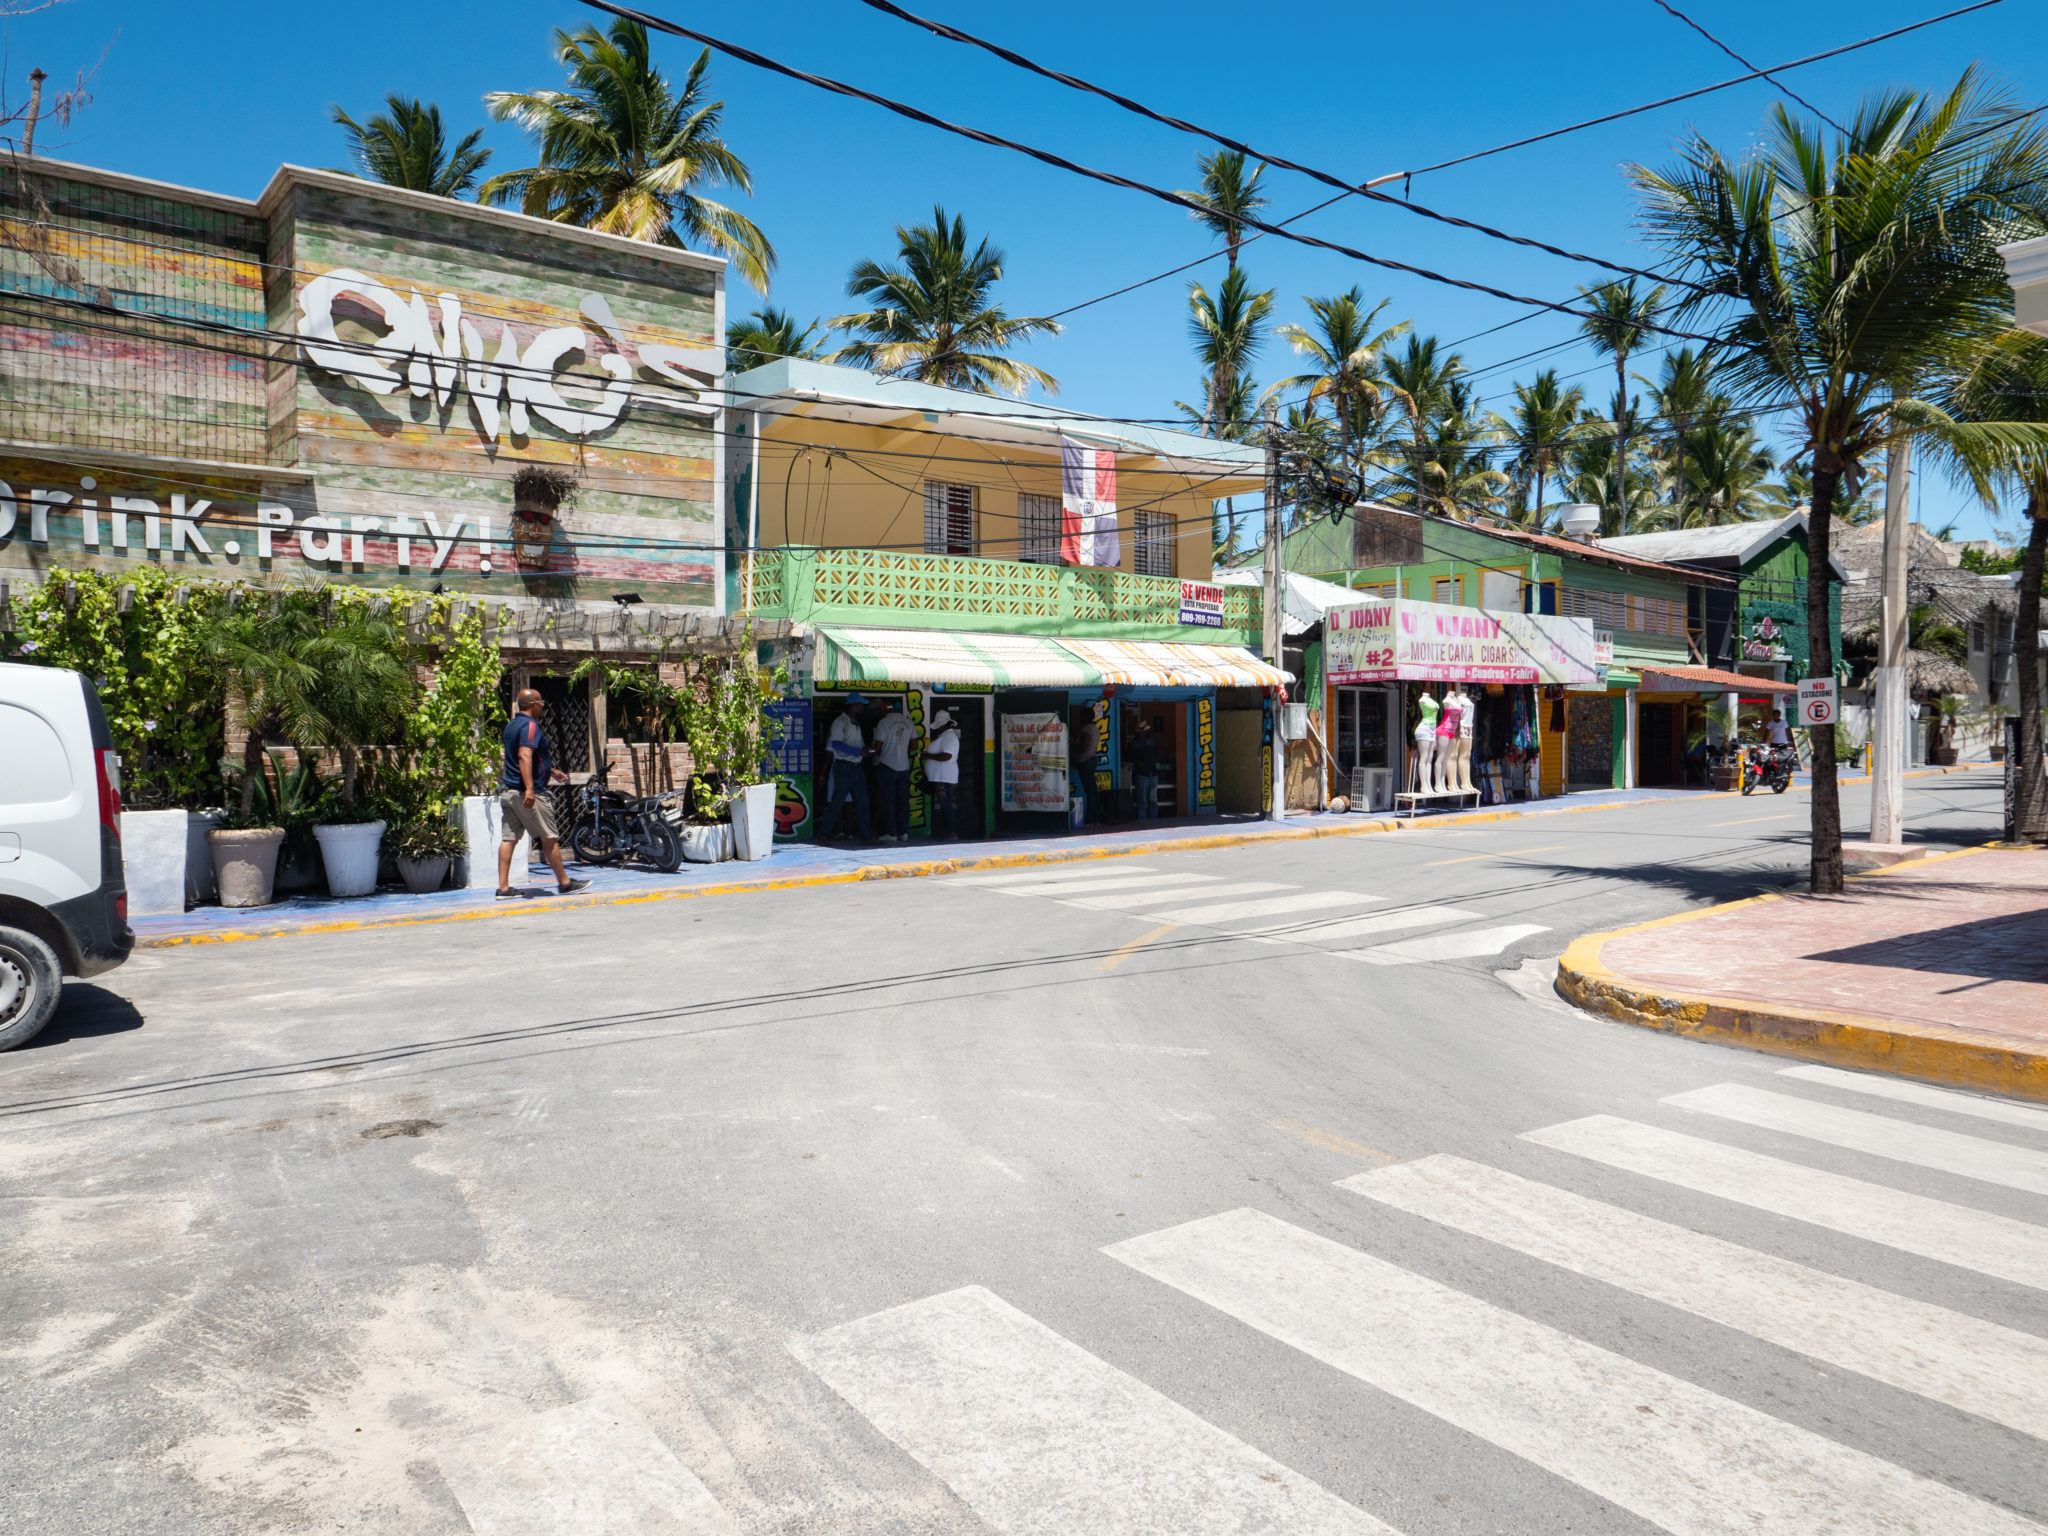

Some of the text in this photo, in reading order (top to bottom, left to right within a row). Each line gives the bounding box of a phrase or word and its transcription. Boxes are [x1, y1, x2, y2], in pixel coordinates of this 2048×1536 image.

[257, 501, 492, 572] Party!
[1182, 583, 1223, 604] SE VENDE
[1185, 600, 1219, 612] ESTA PROPIEDAD
[1349, 606, 1392, 629] JUANY
[1332, 630, 1391, 648] Gift Shop
[1366, 648, 1394, 666] #2
[1410, 641, 1446, 661] MONTE
[1448, 643, 1474, 662] CANA
[1481, 645, 1507, 664] CIGAR
[1449, 666, 1466, 679] Ron
[1510, 668, 1534, 680] T-shirt
[1801, 689, 1833, 699] ESTACIONE
[1812, 682, 1825, 690] NO
